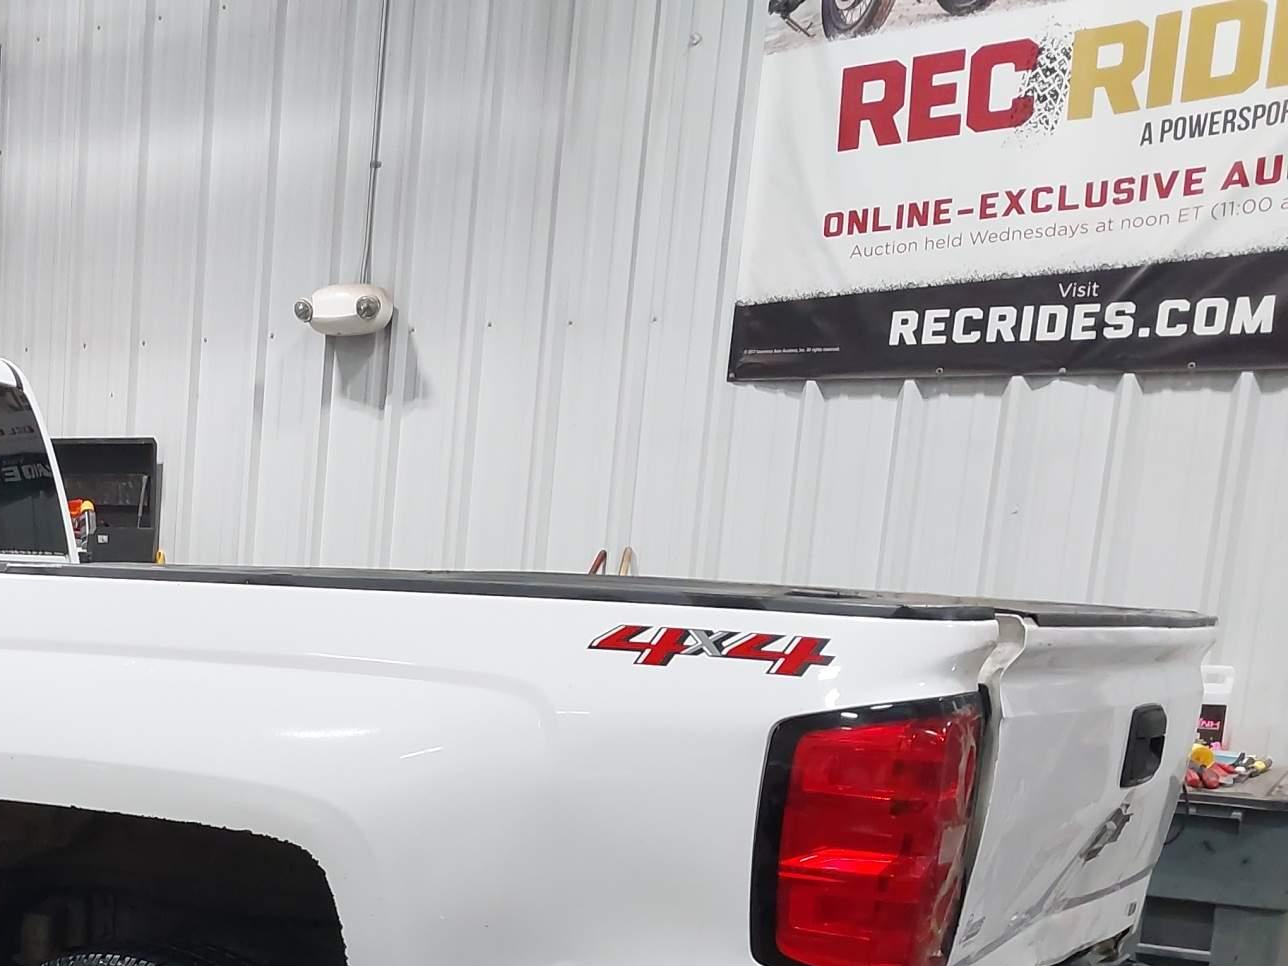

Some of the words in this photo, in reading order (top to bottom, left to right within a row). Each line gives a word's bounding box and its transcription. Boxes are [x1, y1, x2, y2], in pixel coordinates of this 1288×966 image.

[837, 38, 1041, 152] REC
[1139, 121, 1154, 147] A
[823, 166, 1207, 238] ONLINE-EXCLUSIVE
[1220, 154, 1288, 191] AU
[849, 239, 918, 259] Auction
[924, 233, 963, 251] held
[969, 222, 1089, 246] Wednesdays
[1095, 218, 1113, 233] at
[1121, 213, 1170, 230] noon
[1177, 205, 1204, 224] ET
[1210, 196, 1274, 221] (11:00
[1058, 281, 1100, 299] Visit
[888, 294, 1277, 347] RECRIDES.COM
